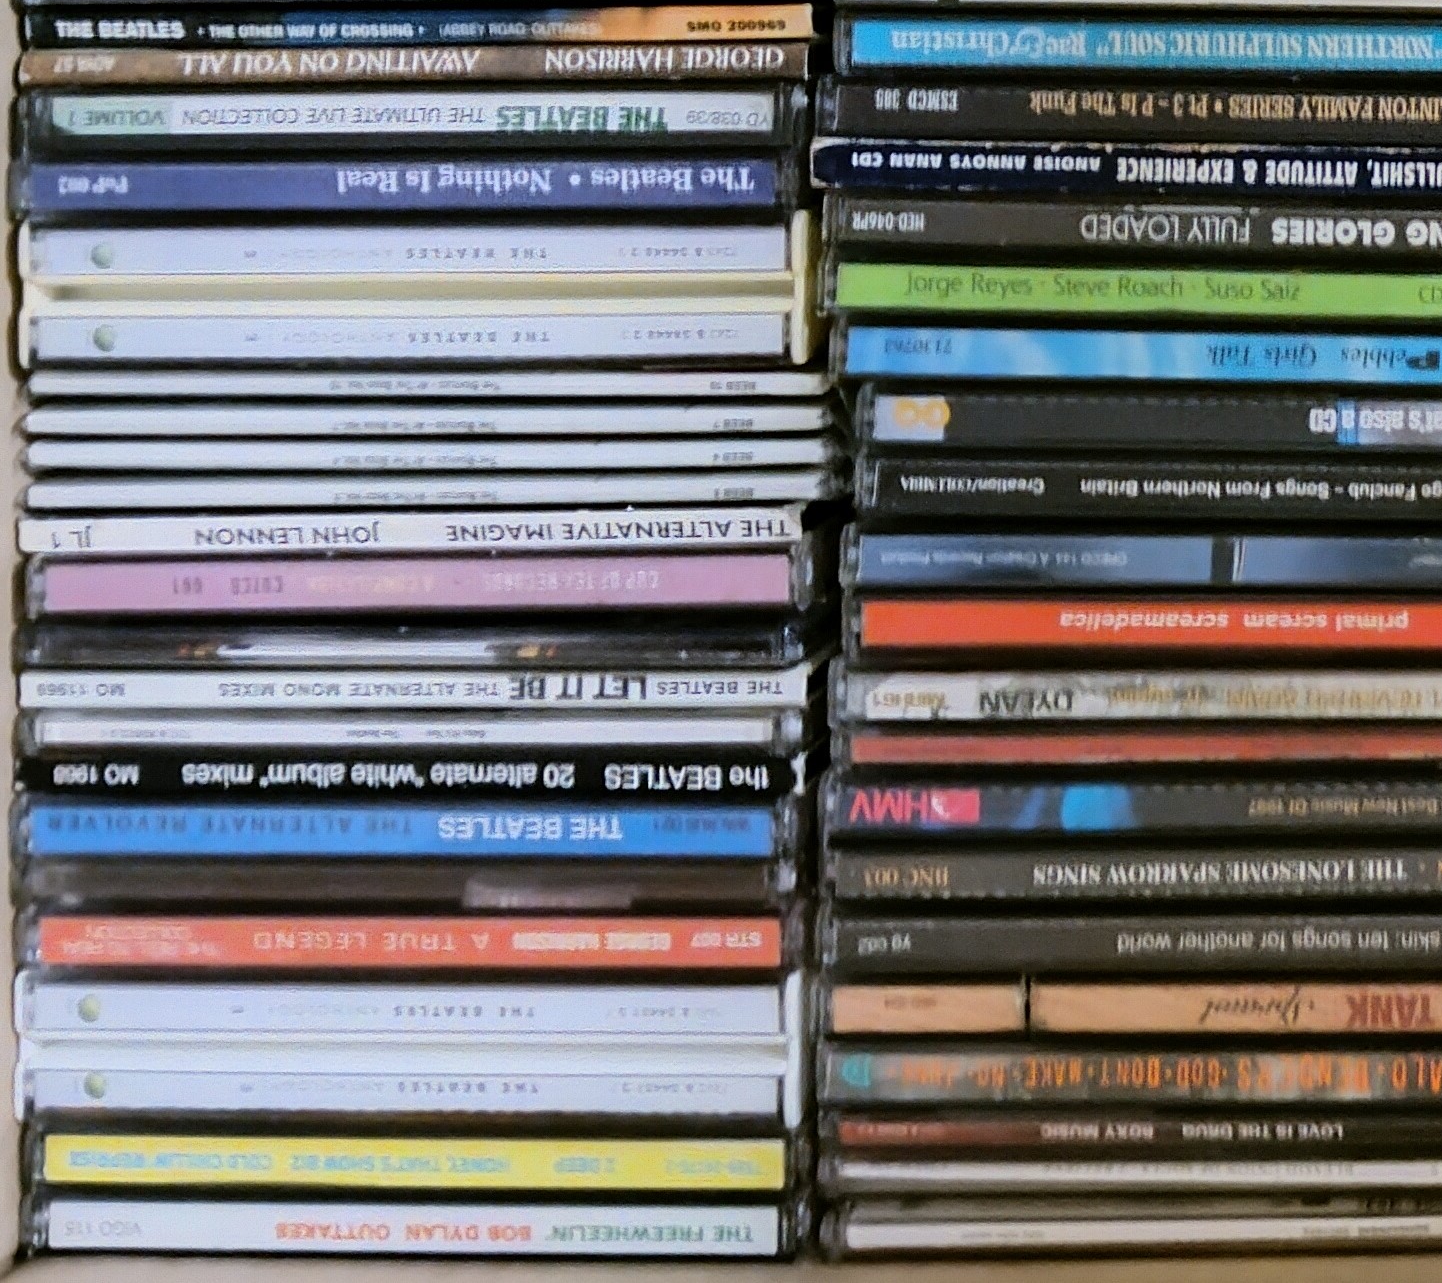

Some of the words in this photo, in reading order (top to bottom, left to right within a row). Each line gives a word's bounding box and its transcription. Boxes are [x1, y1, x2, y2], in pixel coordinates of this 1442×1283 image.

[178, 51, 227, 75] ALL
[234, 50, 291, 74] YOU
[300, 50, 339, 74] ON
[345, 49, 481, 73] AWAITING
[544, 47, 674, 71] HARRISON
[680, 46, 784, 70] GEORGE
[335, 168, 398, 192] Real
[404, 168, 431, 190] Is
[438, 165, 552, 191] Nothing
[591, 167, 693, 190] Beatles
[699, 167, 754, 191] The
[1116, 156, 1235, 183] EXPERIENCE
[1242, 159, 1258, 182] &
[1265, 158, 1358, 185] ATTITUDE
[1079, 213, 1180, 241] LOADED
[1187, 215, 1250, 243] FULLY
[1272, 217, 1396, 245] GLORIES
[1309, 407, 1337, 432] CD
[1342, 409, 1356, 430] a
[1360, 409, 1403, 433] also
[1080, 479, 1138, 499] Britain
[1144, 479, 1221, 500] Northern
[1225, 480, 1271, 499] From
[1276, 478, 1330, 500] Songs
[1347, 480, 1417, 501] Fanclub
[195, 526, 303, 546] LENNON
[309, 521, 380, 545] JOHN
[445, 523, 553, 541] IMAGINE
[562, 520, 731, 540] ALTERNATIVE
[739, 519, 790, 537] THE
[1059, 610, 1228, 632] screamadelica
[1243, 612, 1328, 630] scream
[1335, 609, 1410, 632] primal
[508, 677, 545, 699] BE
[558, 677, 586, 699] IT
[596, 677, 646, 699] LET
[656, 680, 739, 695] BEATLES
[746, 680, 782, 695] THE
[182, 762, 254, 784] mixes
[431, 762, 537, 786] alternate
[544, 763, 575, 786] 20
[605, 764, 722, 788] BEATLES
[729, 764, 768, 788] the
[849, 790, 929, 822] HMV
[64, 1220, 98, 1236] 115
[103, 1220, 141, 1236] VIGO
[274, 1223, 390, 1241] OUTTAKES
[405, 1224, 479, 1241] DYLAN
[486, 1224, 532, 1242] BOB
[711, 1225, 753, 1244] THE
